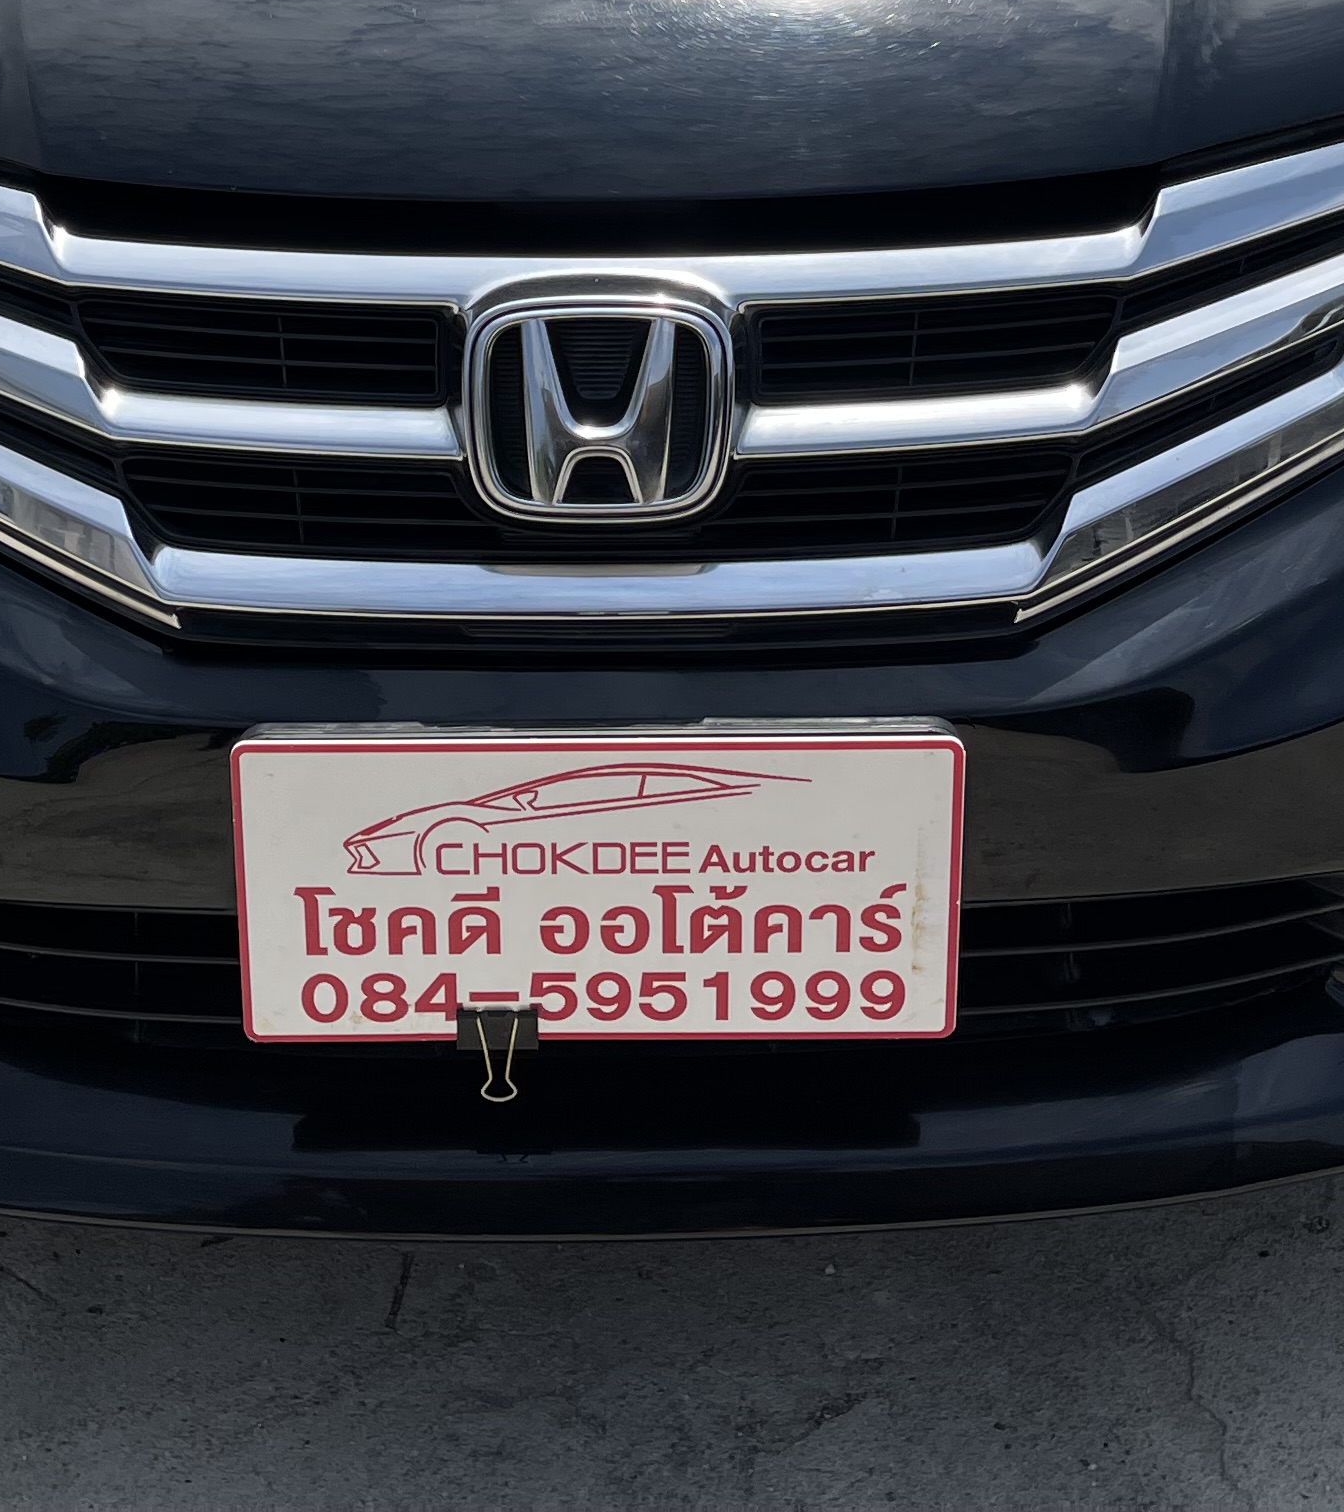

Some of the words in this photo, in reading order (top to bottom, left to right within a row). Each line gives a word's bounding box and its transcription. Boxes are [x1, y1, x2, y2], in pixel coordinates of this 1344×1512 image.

[435, 841, 691, 876] CHOKDEE
[698, 844, 876, 874] Autocar
[293, 885, 502, 956] โชคดี
[539, 882, 907, 955] ออโต้คาร์
[301, 969, 906, 1023] 084-5951999
